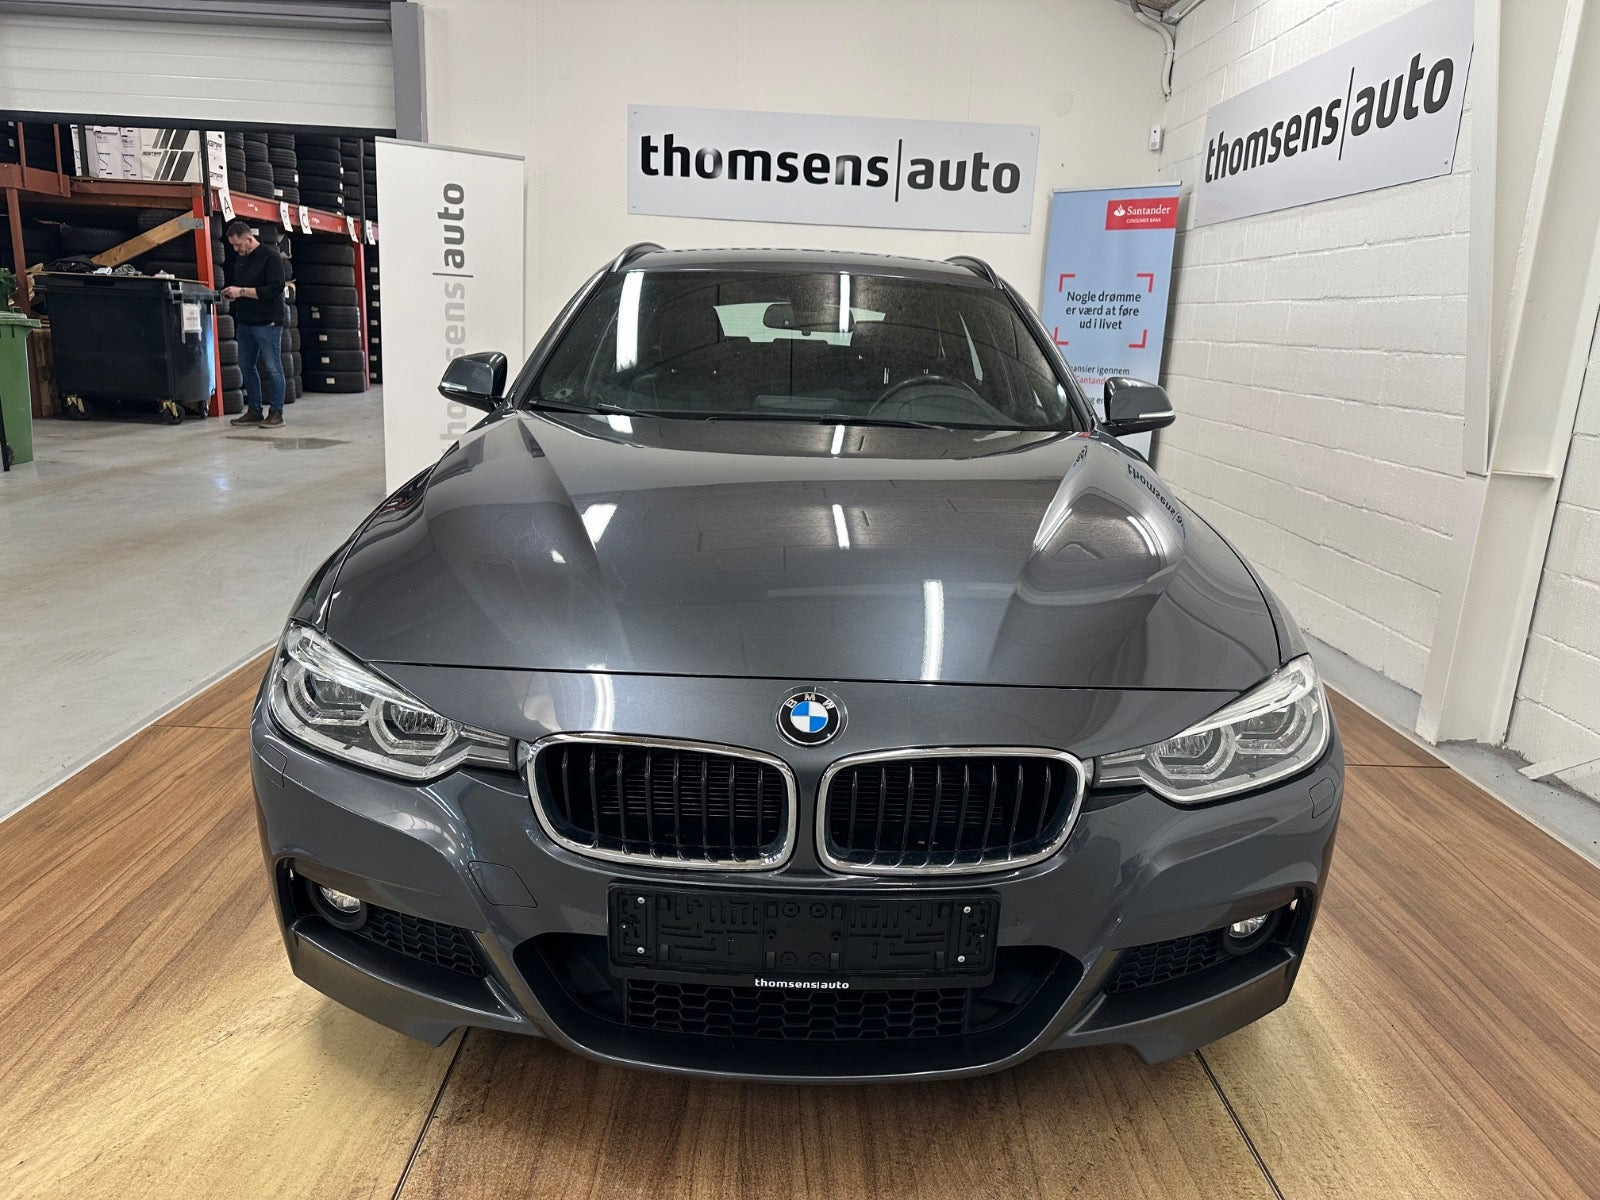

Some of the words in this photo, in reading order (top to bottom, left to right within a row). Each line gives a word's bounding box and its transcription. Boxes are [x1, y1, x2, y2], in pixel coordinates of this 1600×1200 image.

[1205, 98, 1342, 184] thomsens
[1350, 52, 1454, 137] auto
[640, 133, 889, 188] thomsens
[907, 152, 1021, 194] auto
[224, 196, 232, 213] A
[1126, 203, 1171, 216] Santander
[437, 183, 465, 269] auto
[1066, 290, 1097, 304] Nogle
[1098, 291, 1141, 303] drømme
[1065, 307, 1077, 316] er
[1078, 305, 1104, 316] værd
[1105, 306, 1117, 316] at
[1118, 305, 1140, 317] føre
[1079, 318, 1092, 329] ud
[1093, 318, 1098, 329] i
[1099, 318, 1123, 330] livet
[1097, 364, 1130, 376] igennem
[785, 692, 835, 710] BMW
[755, 978, 817, 989] thomsens
[820, 981, 850, 989] auto
